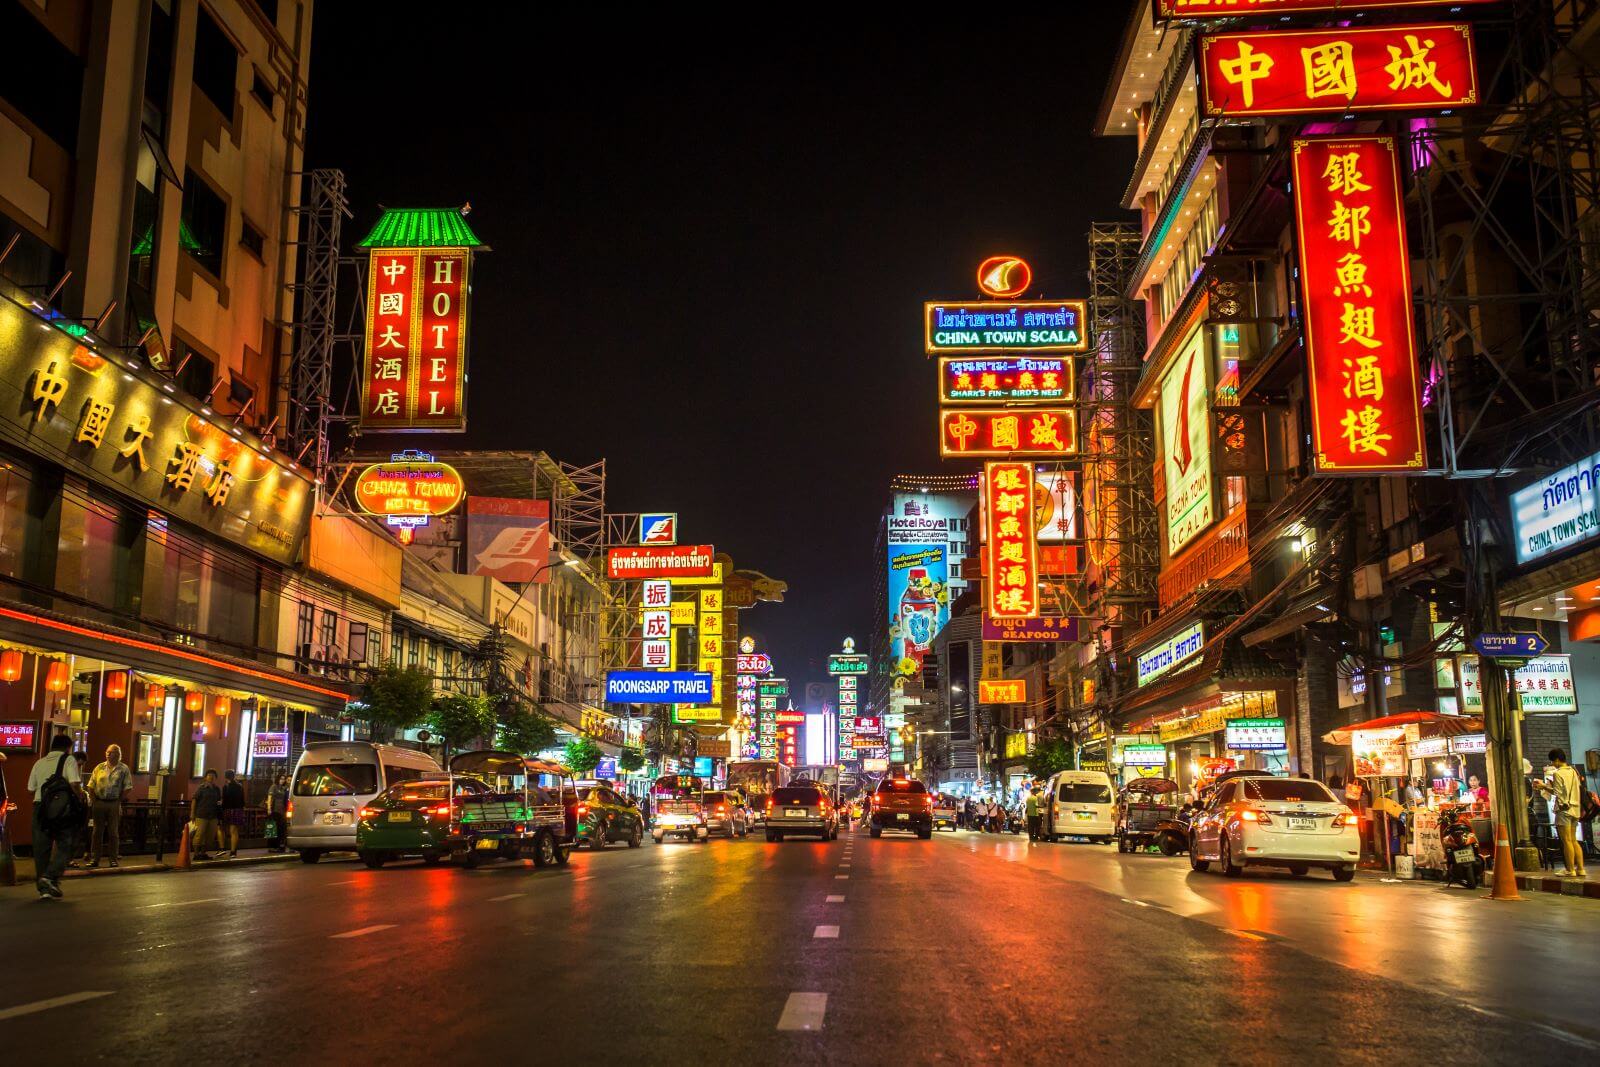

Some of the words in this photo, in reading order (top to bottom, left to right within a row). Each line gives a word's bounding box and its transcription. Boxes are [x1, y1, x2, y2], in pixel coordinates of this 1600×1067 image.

[1217, 34, 1453, 109] 中國城
[1320, 152, 1392, 457] 銀都魚翅酒樓
[372, 259, 406, 415] 中國大酒店
[428, 260, 454, 415] HOTEL
[935, 332, 980, 344] CHINA
[984, 331, 1027, 343] TOWN
[1030, 330, 1077, 343] SCALA
[1041, 388, 1062, 396] NEST
[32, 361, 236, 507] 中國大酒店
[949, 414, 1064, 450] 中國城
[363, 481, 409, 496] CHINA
[415, 481, 456, 497] TOWN
[385, 498, 430, 512] HOTEL
[1170, 491, 1189, 520] CHINA
[1190, 471, 1208, 500] TOWN
[889, 518, 918, 528] Hotel
[919, 518, 947, 530] Royal
[992, 468, 1031, 614] 銀都魚翅酒樓
[1171, 506, 1209, 550] SCALA
[1528, 534, 1553, 553] CHINA
[1552, 519, 1576, 541] TOWN
[647, 585, 667, 665] 振成豐
[1003, 631, 1060, 639] SEAFOOD
[1527, 638, 1537, 650] 2
[609, 680, 670, 694] ROONGSARP
[672, 681, 709, 694] TRAVEL
